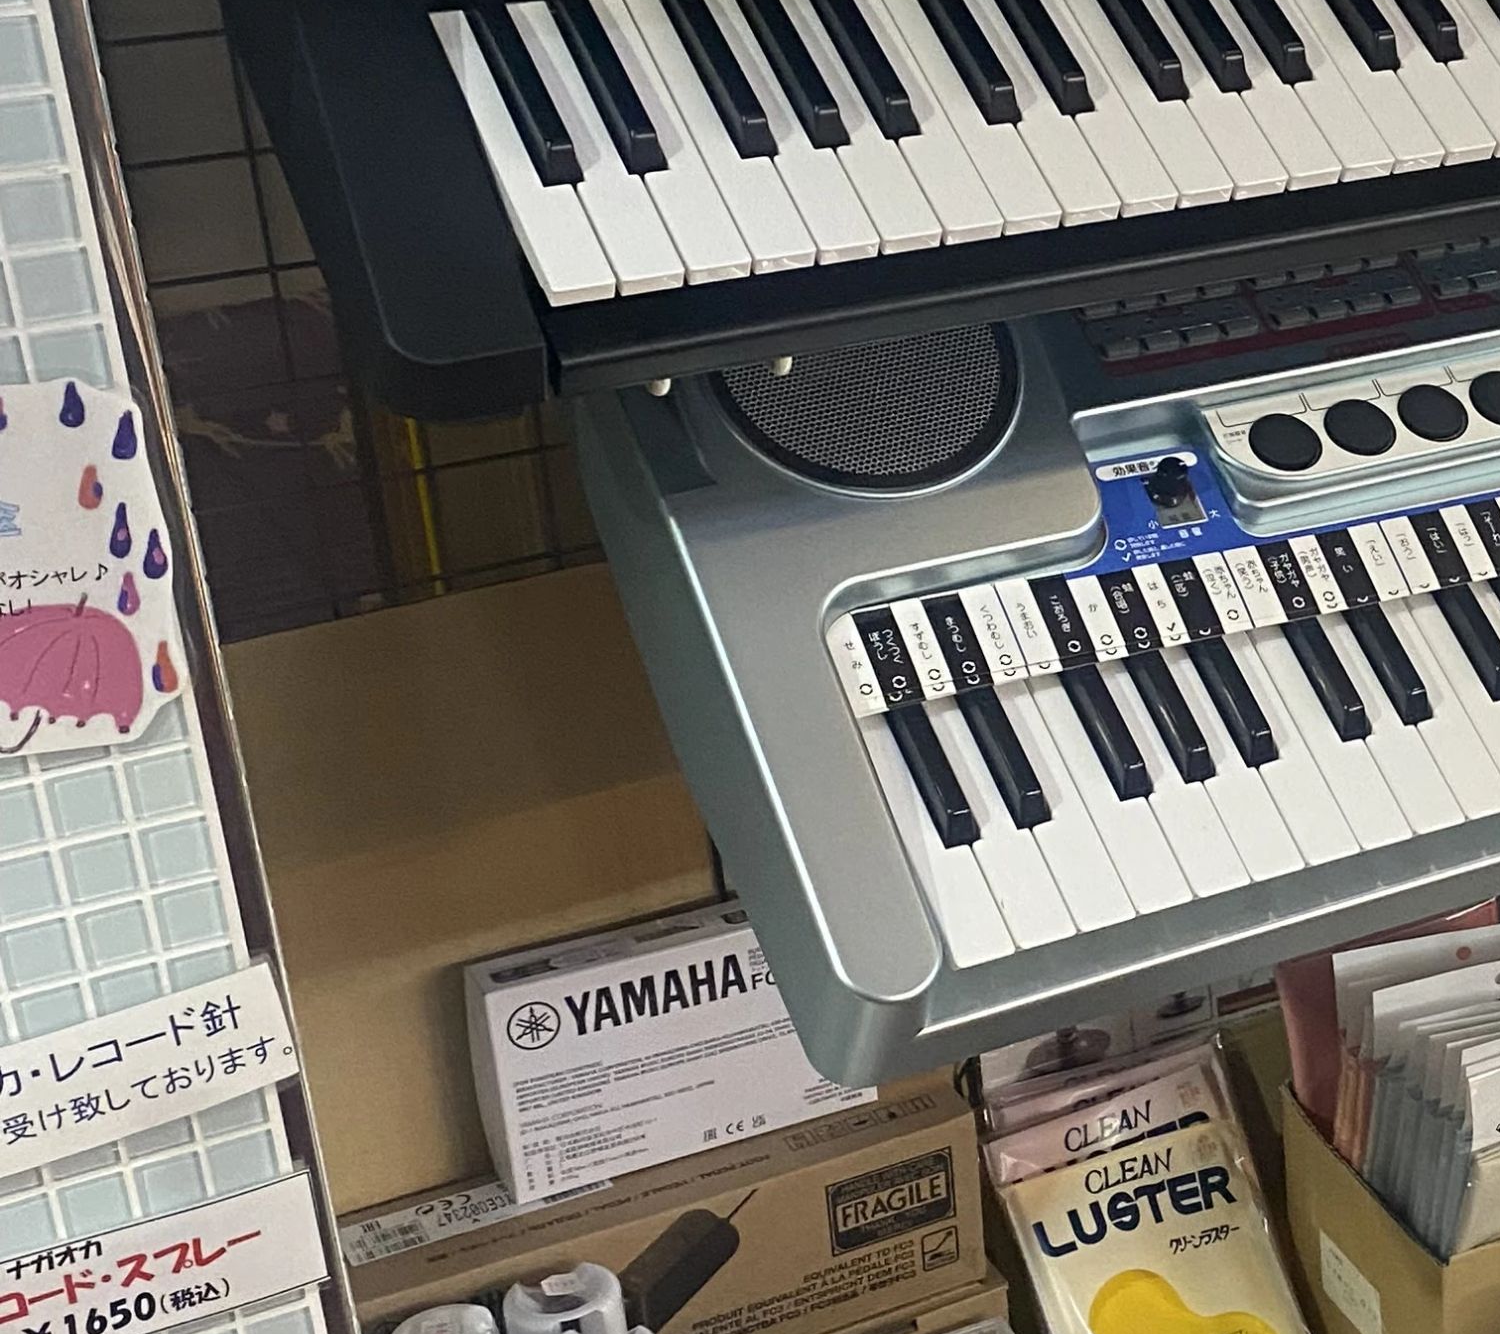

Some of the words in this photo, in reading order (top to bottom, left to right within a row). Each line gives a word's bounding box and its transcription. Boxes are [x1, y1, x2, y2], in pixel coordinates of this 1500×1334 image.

[563, 953, 748, 1036] YAMAHA
[1064, 1099, 1152, 1153] CLEAN
[1084, 1147, 1174, 1195] CLEAN
[839, 1172, 945, 1230] FRAGILE
[1032, 1165, 1237, 1258] LUSTER
[8, 1239, 103, 1280] ナガオカ
[1168, 1223, 1241, 1255] クリーンラスター
[803, 1252, 874, 1283] EQUIVALENT
[876, 1248, 891, 1260] TO
